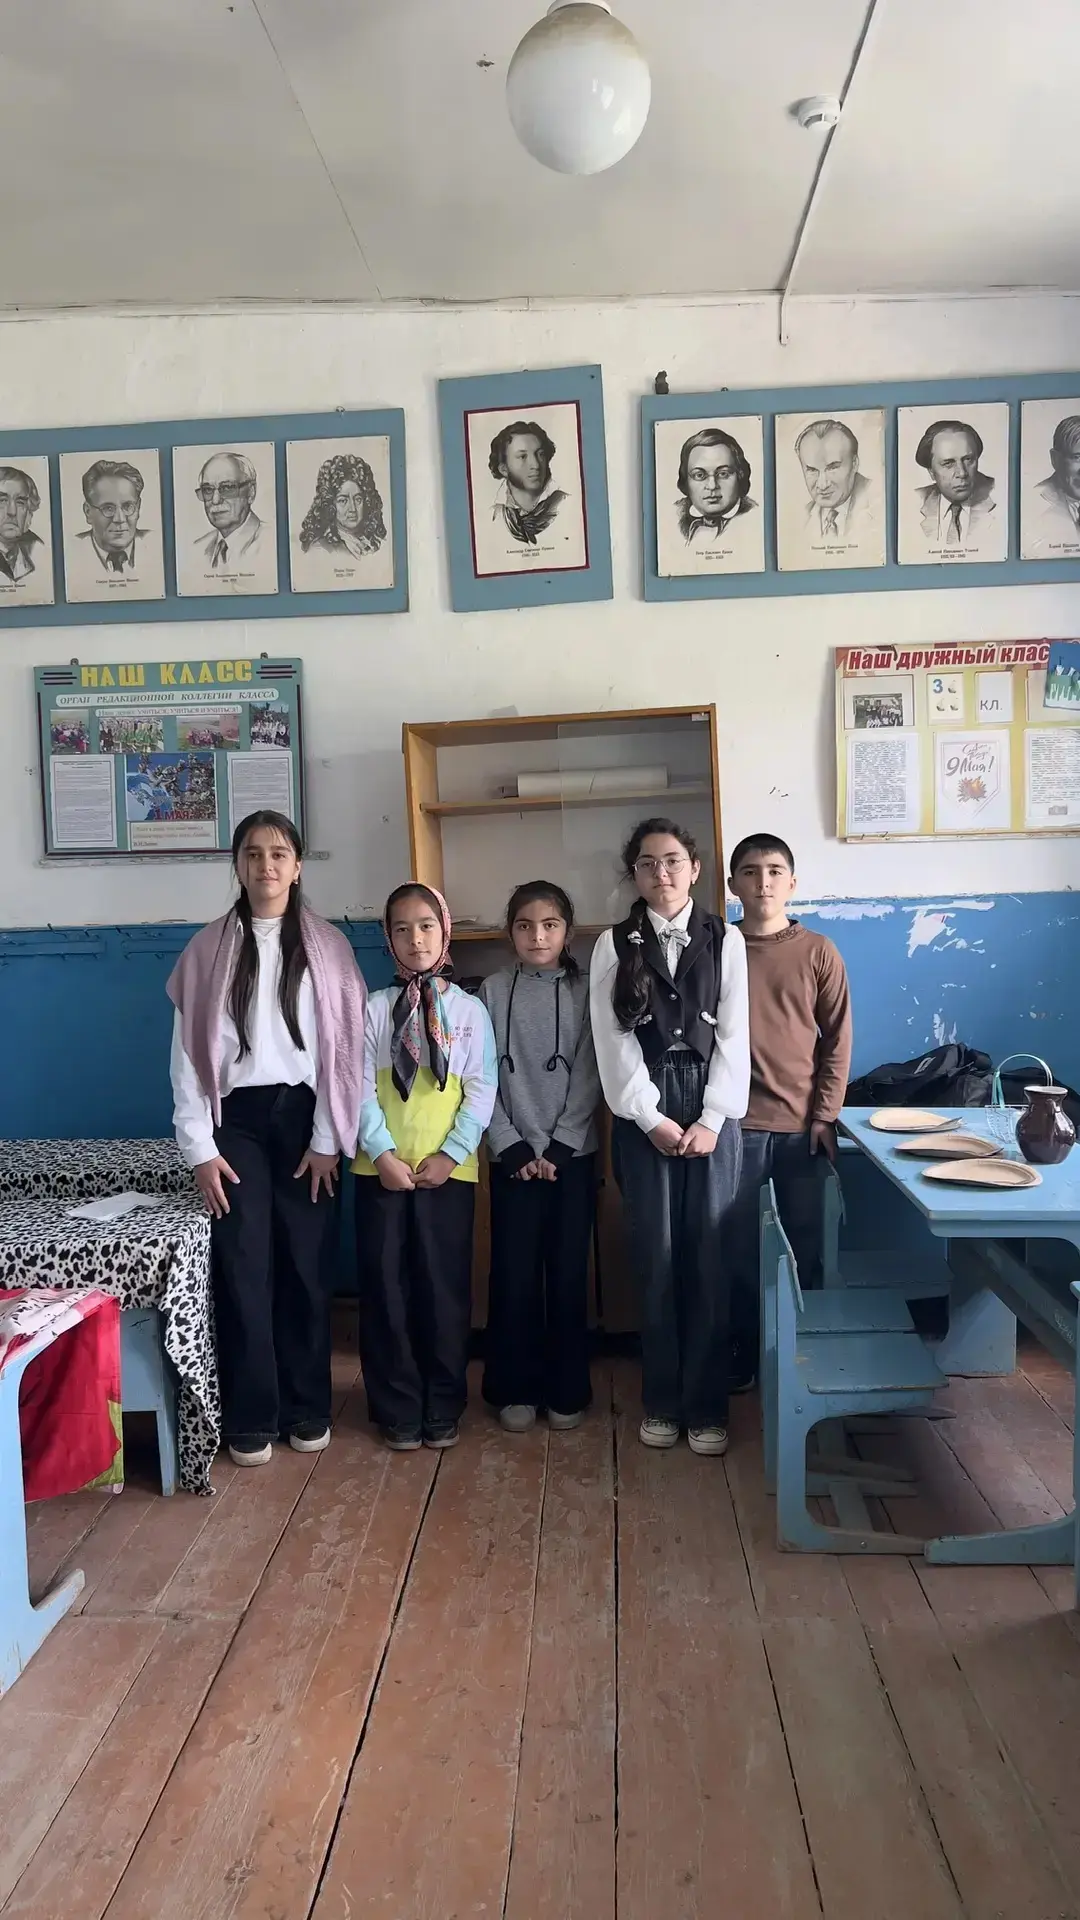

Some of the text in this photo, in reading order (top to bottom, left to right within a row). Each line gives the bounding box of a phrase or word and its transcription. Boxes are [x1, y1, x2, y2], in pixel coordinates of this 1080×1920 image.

[849, 651, 892, 670] Наш
[896, 644, 994, 670] дружный
[80, 660, 252, 687] НАШ КЛАСС
[60, 696, 91, 705] ОРГАН
[239, 690, 275, 699] КЛАССА
[945, 756, 960, 776] 9
